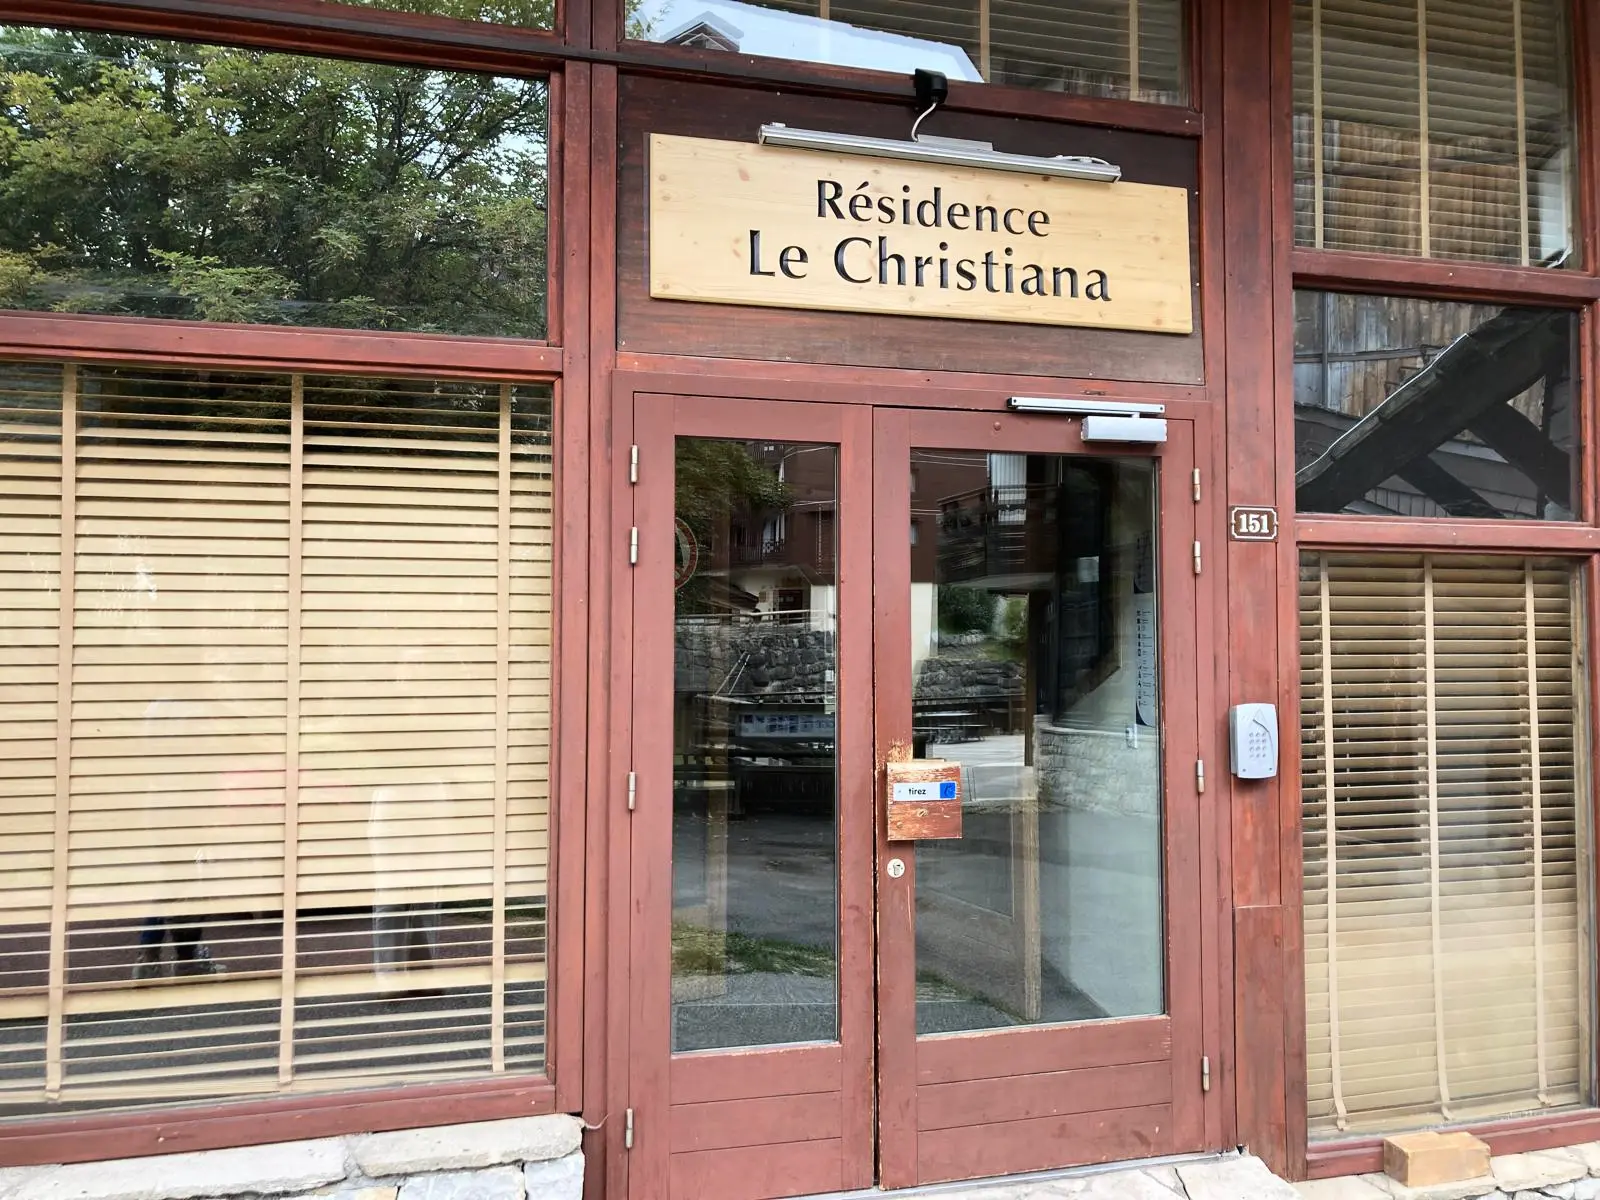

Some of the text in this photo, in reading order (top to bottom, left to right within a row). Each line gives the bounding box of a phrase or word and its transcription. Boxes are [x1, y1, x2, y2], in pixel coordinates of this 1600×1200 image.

[816, 178, 1051, 238] Résidence
[749, 229, 1112, 302] Le Christiana
[1239, 513, 1270, 533] 151
[908, 787, 927, 795] tirez
